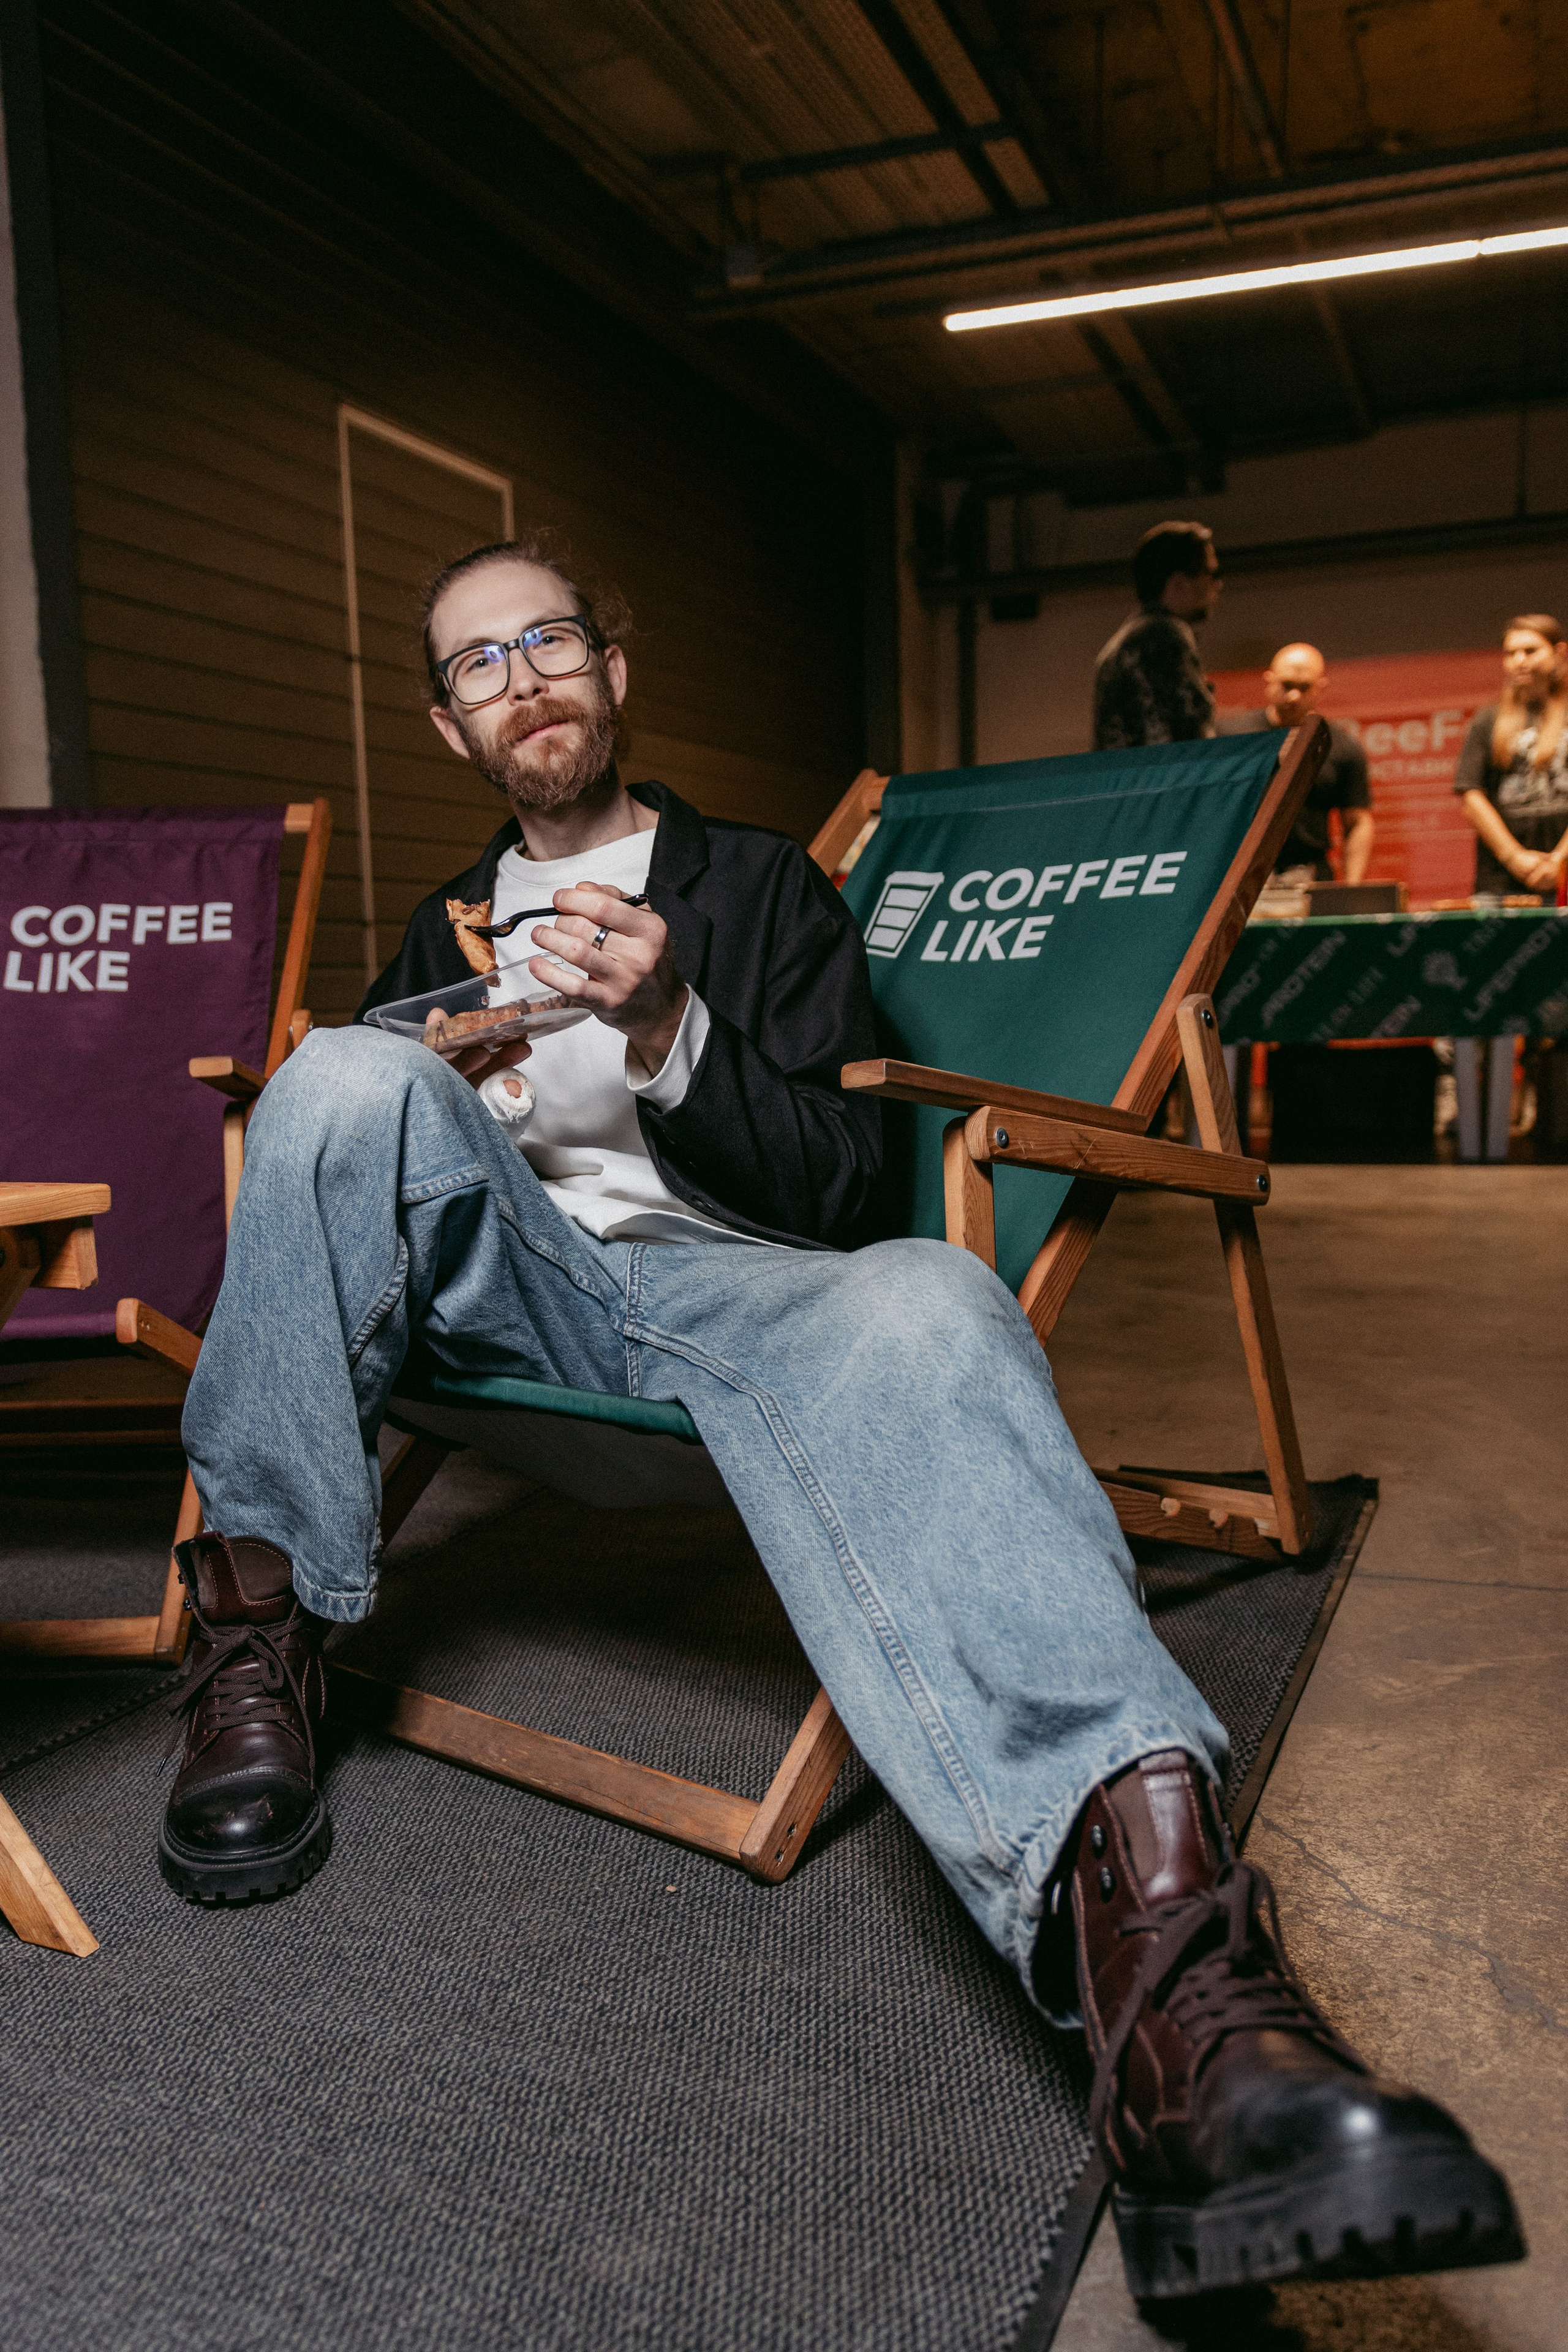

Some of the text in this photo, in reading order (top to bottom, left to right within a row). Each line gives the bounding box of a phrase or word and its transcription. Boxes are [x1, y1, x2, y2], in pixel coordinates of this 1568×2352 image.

[948, 850, 1188, 913] COFFEE
[10, 901, 234, 948] COFFEE
[919, 914, 1055, 963] LIKE
[3, 949, 131, 993] LIKE
